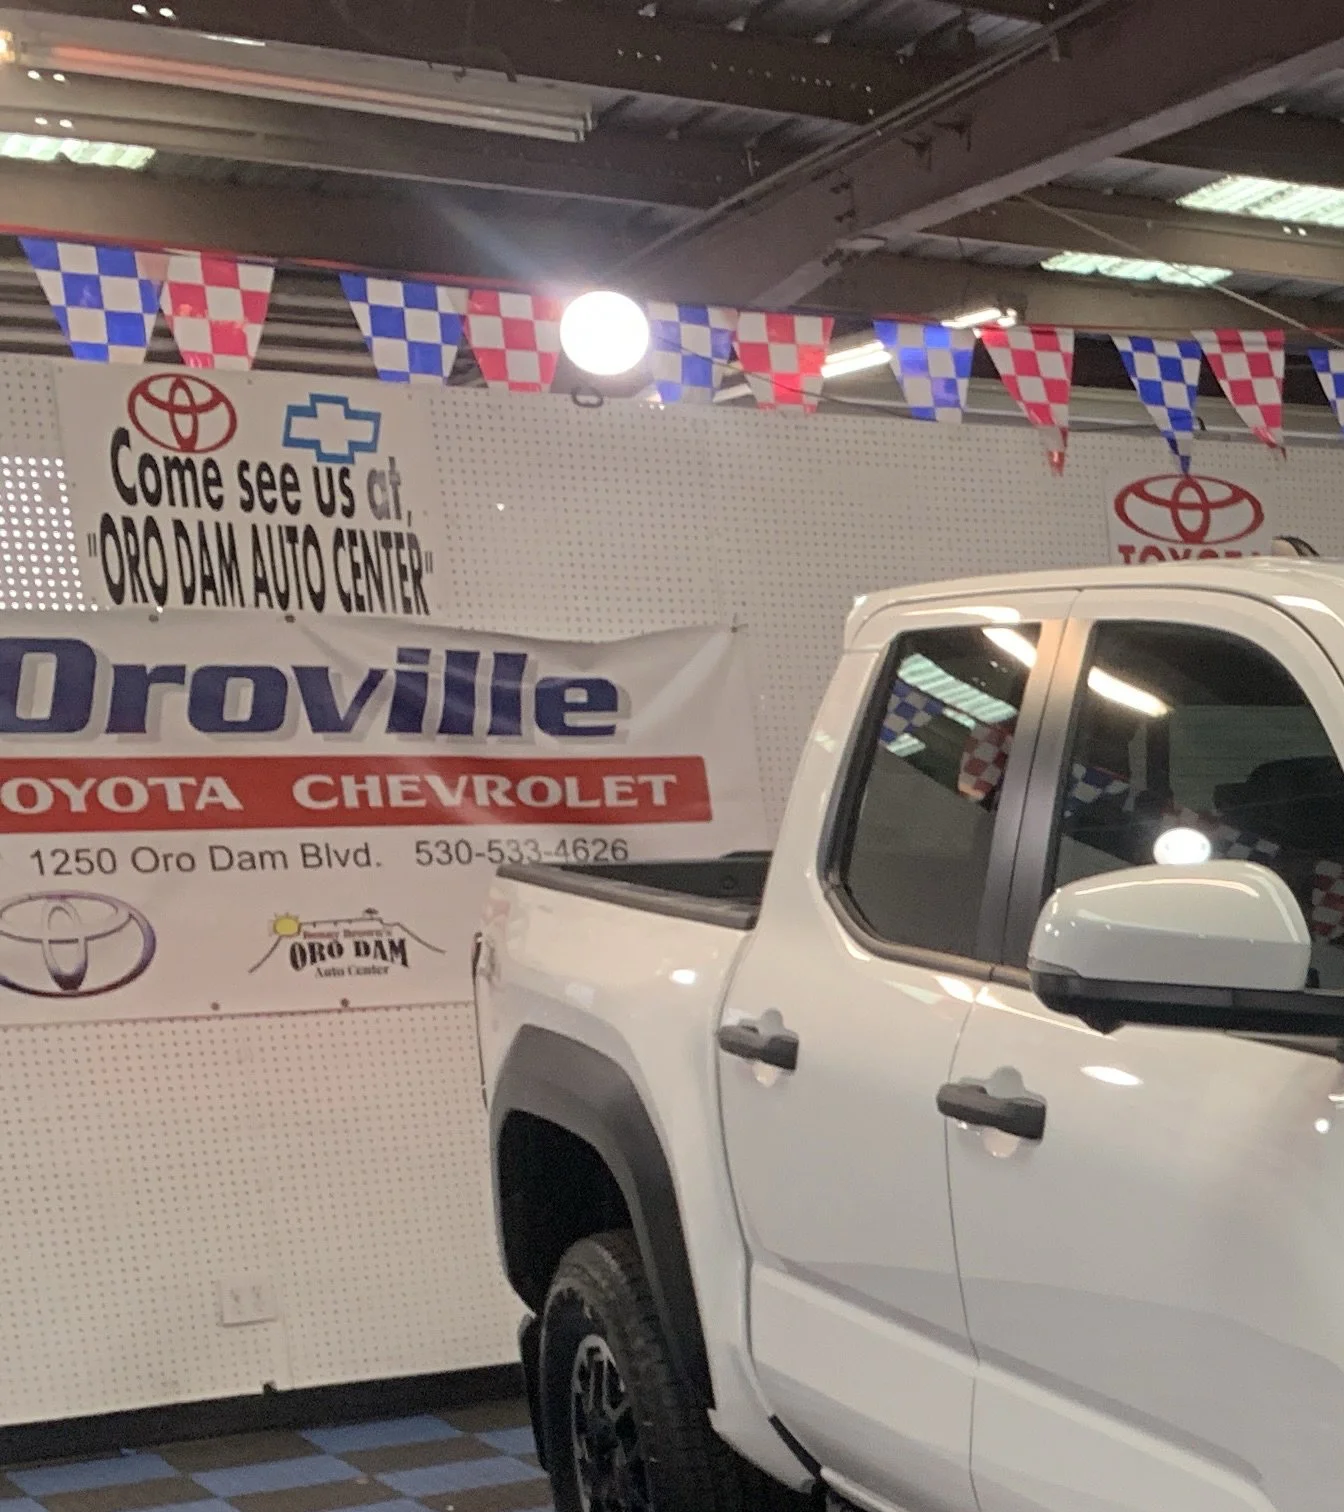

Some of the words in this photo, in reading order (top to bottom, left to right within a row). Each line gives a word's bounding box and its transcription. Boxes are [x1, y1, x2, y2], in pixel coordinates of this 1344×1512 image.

[110, 426, 224, 510] Come
[237, 456, 303, 515] see
[313, 464, 356, 519] us
[172, 517, 246, 608] DAM
[250, 523, 326, 613] AUTO
[1117, 544, 1262, 565] TOY
[0, 636, 620, 738] Oroville
[0, 775, 245, 815] OYOTA
[292, 773, 678, 811] CHEVROLET
[30, 847, 117, 876] 1250
[130, 846, 196, 873] Oro
[208, 844, 289, 872] Dam
[300, 842, 382, 869] Blvd.
[415, 837, 629, 867] 530-533-4626
[290, 940, 344, 972] ORO
[353, 938, 409, 968] DAM
[314, 966, 345, 978] Auto
[347, 964, 389, 976] Center
